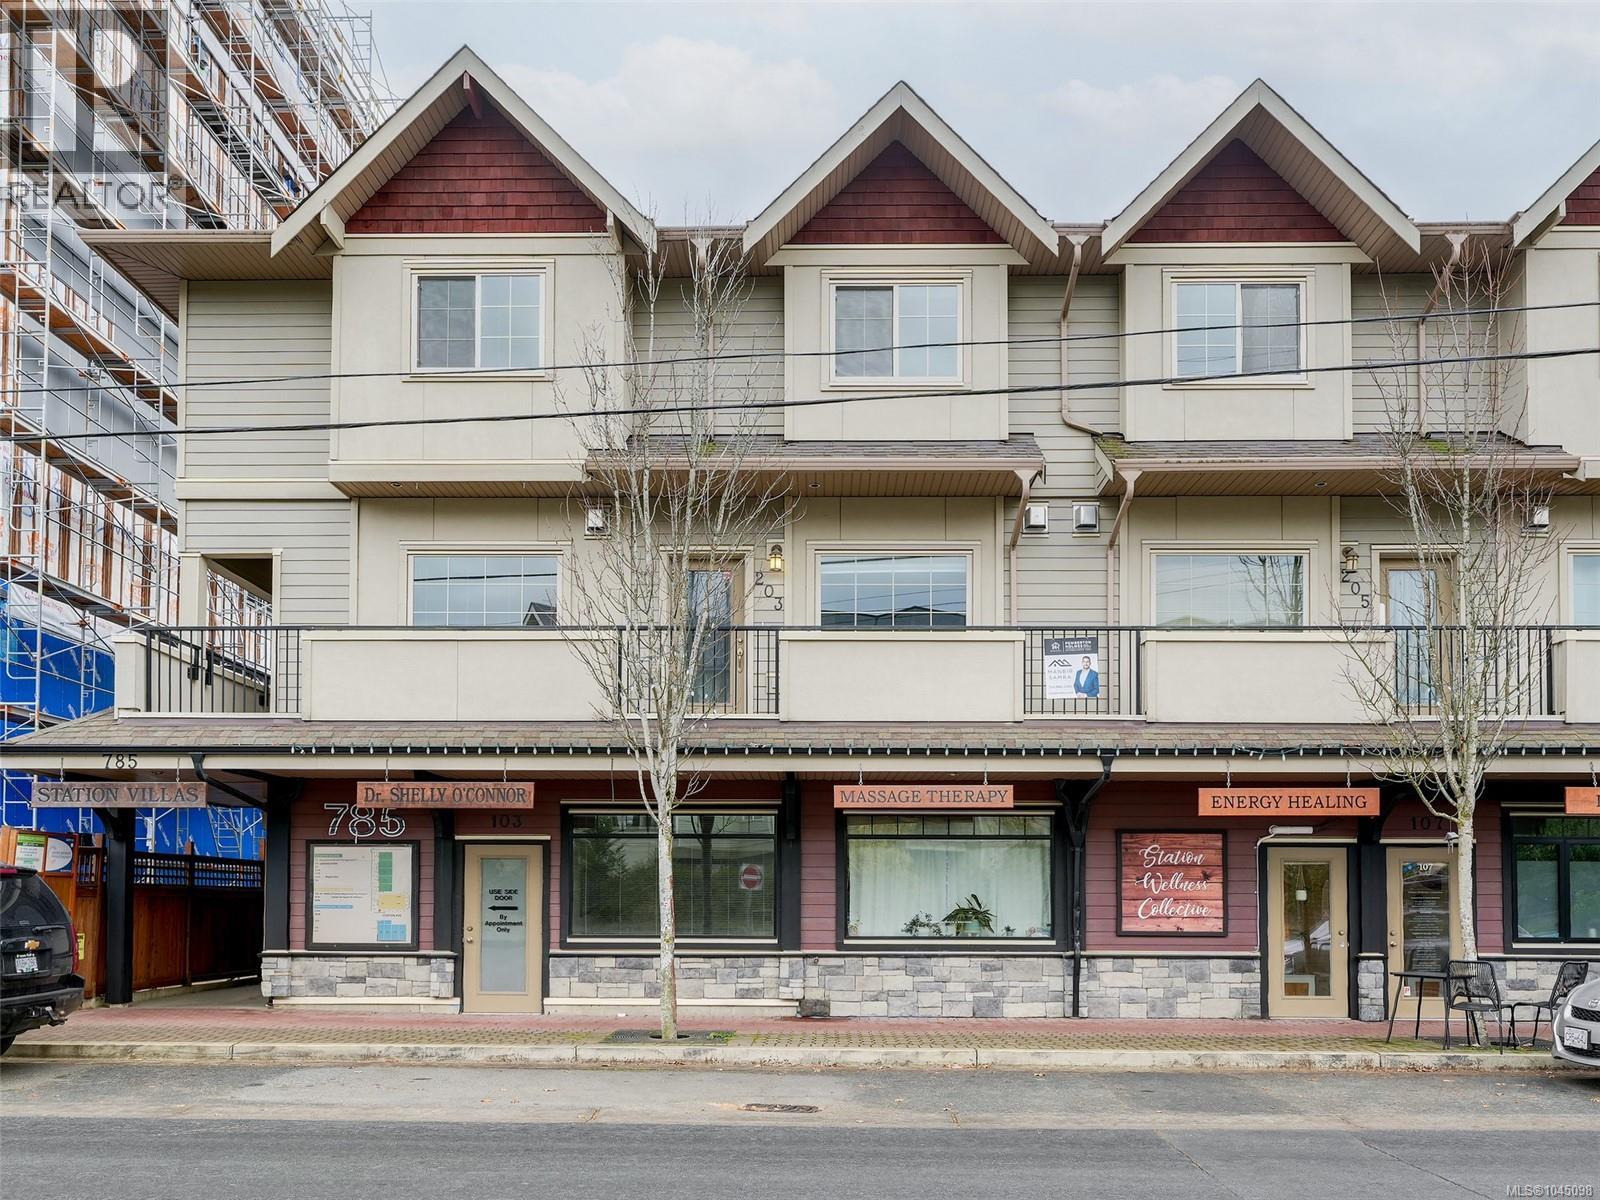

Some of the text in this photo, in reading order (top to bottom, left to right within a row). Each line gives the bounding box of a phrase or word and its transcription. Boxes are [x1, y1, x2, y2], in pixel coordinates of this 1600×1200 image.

[755, 571, 783, 611] 203
[102, 753, 138, 769] 785
[38, 786, 199, 802] STATION VILLAS
[363, 786, 527, 803] Dr. SHELLY O'CONNOR
[840, 789, 1008, 803] MASSAGE THERAPY
[1211, 795, 1367, 809] ENERGY HEALING
[324, 803, 406, 838] 785
[490, 814, 523, 828] 103
[1411, 815, 1444, 830] 107
[1139, 844, 1206, 868] Station
[1419, 863, 1434, 871] 107
[1135, 871, 1208, 894] Wellness
[1138, 897, 1211, 919] Collective
